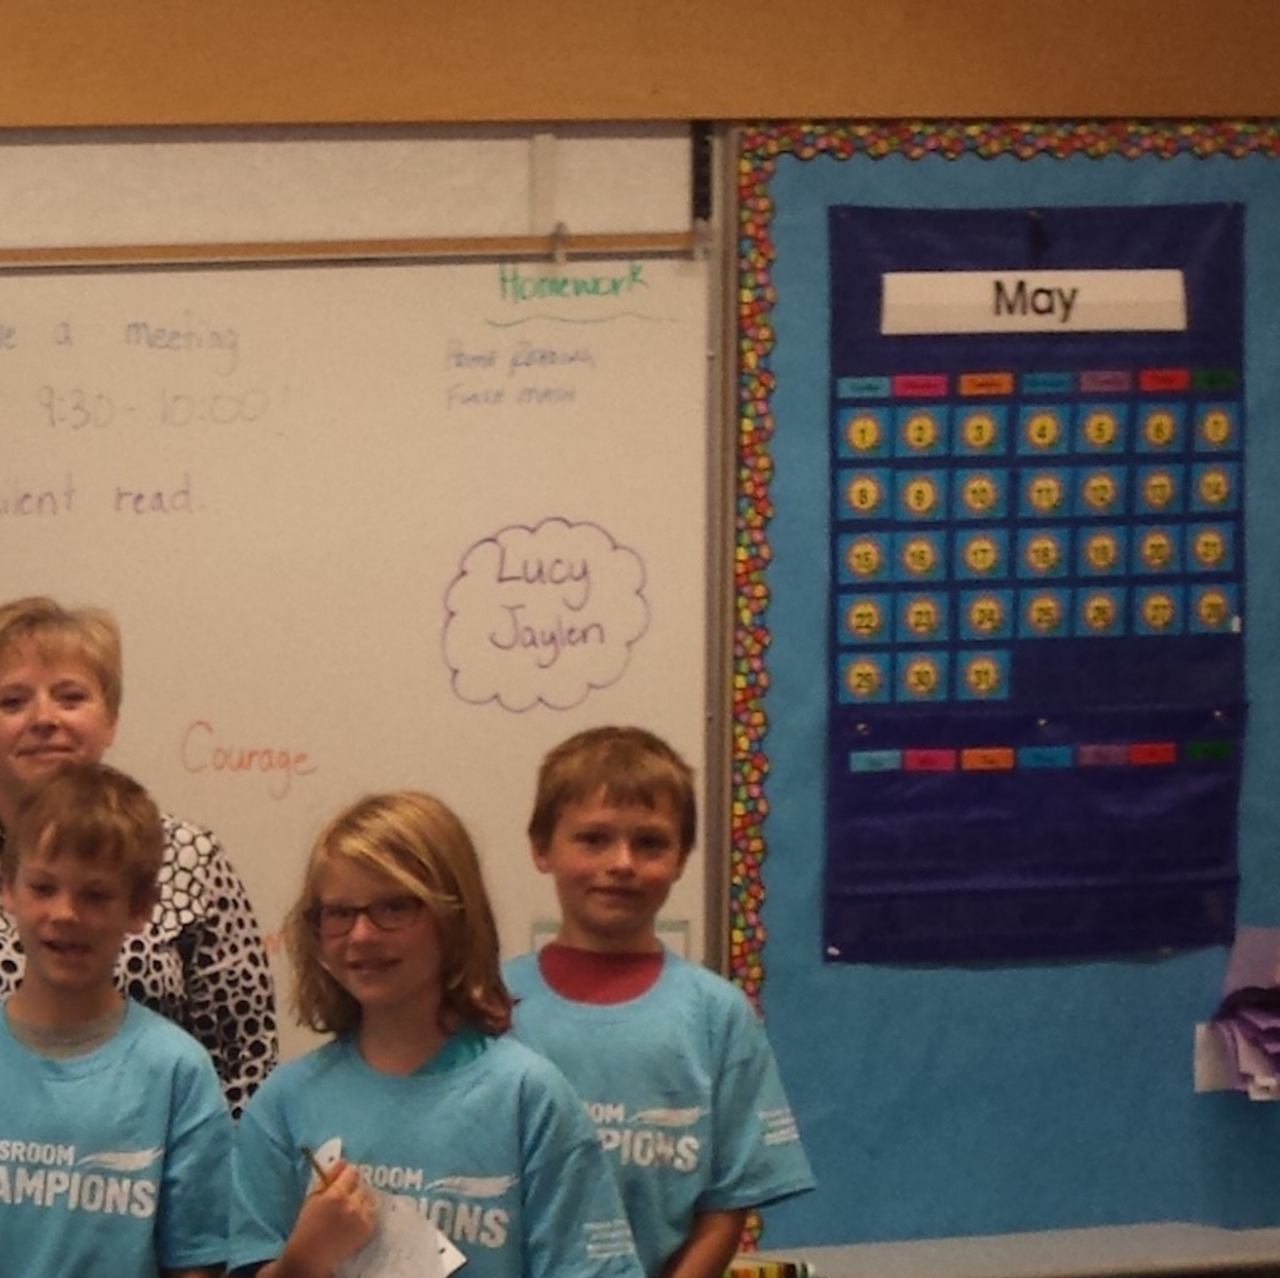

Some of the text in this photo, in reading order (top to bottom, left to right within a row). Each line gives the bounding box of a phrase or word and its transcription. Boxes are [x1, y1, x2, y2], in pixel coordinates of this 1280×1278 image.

[54, 321, 73, 346] a
[993, 279, 1079, 323] May
[496, 547, 592, 612] Lucy
[488, 603, 606, 670] Jaylen
[181, 719, 318, 800] Courage
